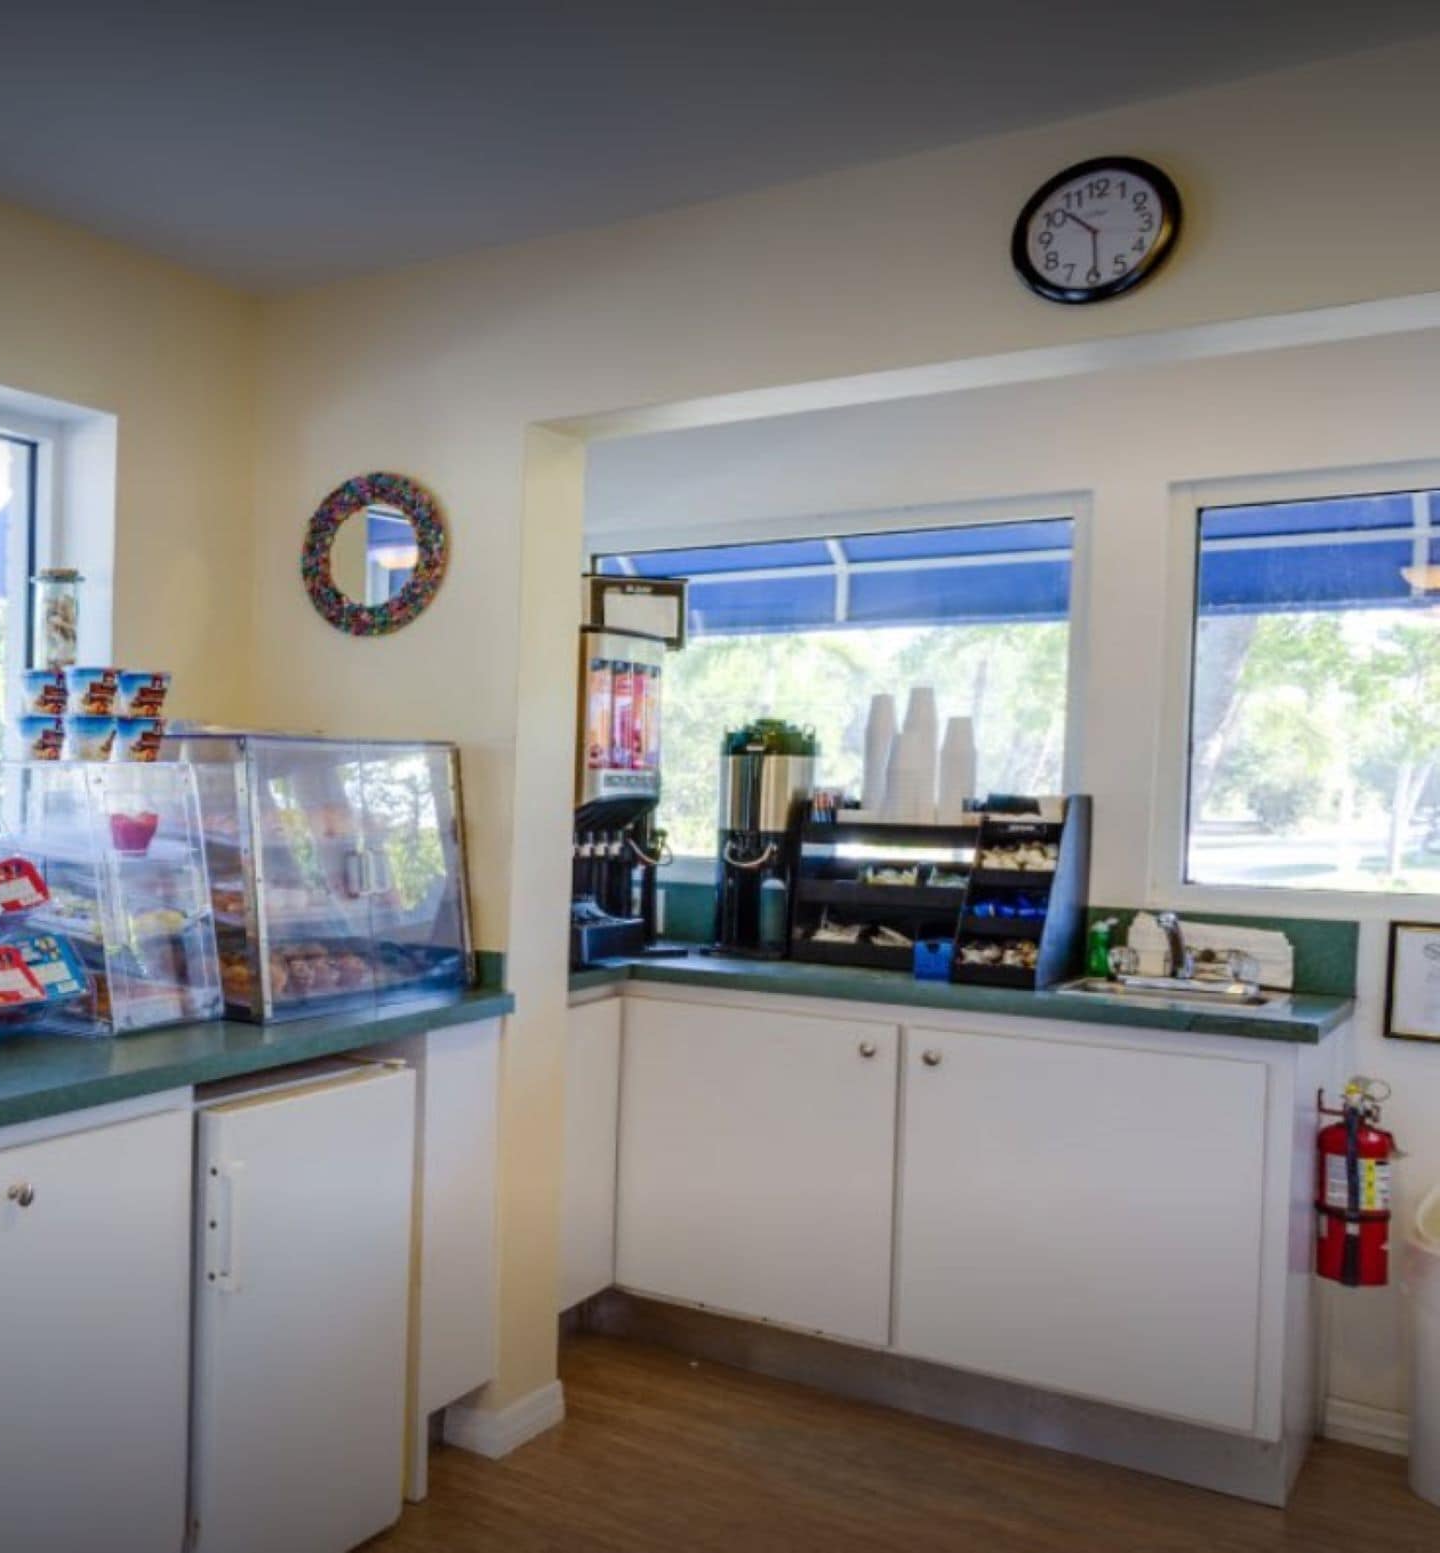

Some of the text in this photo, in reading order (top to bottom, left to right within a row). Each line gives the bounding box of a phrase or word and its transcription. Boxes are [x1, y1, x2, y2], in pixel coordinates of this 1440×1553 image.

[1084, 178, 1110, 199] 12
[1117, 181, 1127, 199] 1
[1063, 190, 1083, 209] 11
[1132, 191, 1148, 212] 2
[1044, 208, 1066, 228] 10
[1139, 213, 1153, 233] 3
[1038, 231, 1054, 250] 9
[1132, 236, 1145, 252] 4
[1044, 252, 1059, 270] 8
[1113, 254, 1127, 274] 5
[1063, 263, 1077, 282] 7
